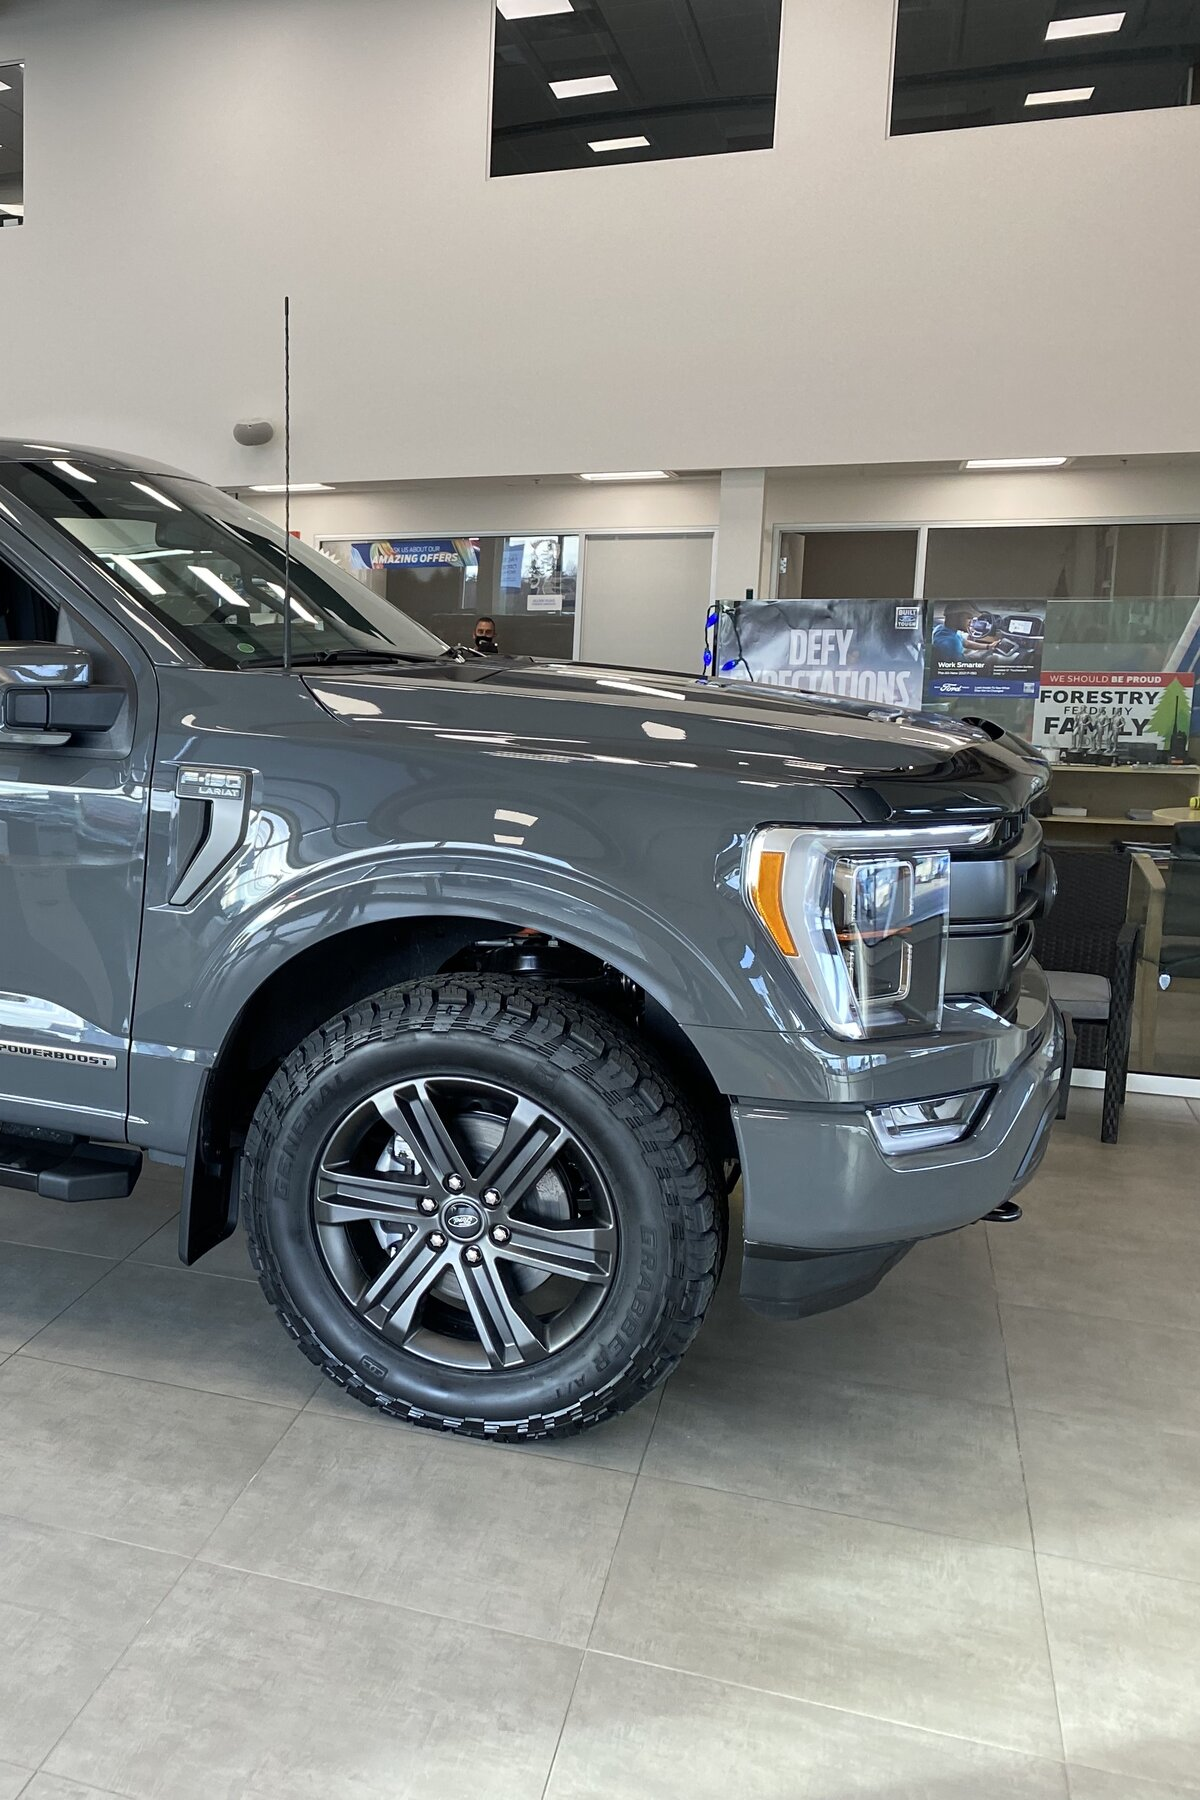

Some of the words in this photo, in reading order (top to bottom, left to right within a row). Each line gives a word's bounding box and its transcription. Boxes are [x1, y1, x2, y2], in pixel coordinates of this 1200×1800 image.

[371, 554, 418, 565] AMAZING
[419, 552, 458, 564] OFFERS
[789, 629, 854, 666] DEFY
[957, 661, 986, 669] Smarter
[1050, 675, 1064, 683] WE
[1067, 675, 1108, 683] SHOULD
[1111, 675, 1124, 683] BE
[1126, 675, 1161, 684] PROUD
[732, 670, 911, 707] CTATIONS
[940, 683, 963, 692] Ford
[1040, 690, 1159, 704] FORESTRY
[1064, 706, 1107, 715] FEDS
[181, 771, 242, 789] F-150
[198, 786, 240, 797] LARIAT
[273, 1072, 345, 1200] GENERAL
[590, 1224, 658, 1373] GRABBER
